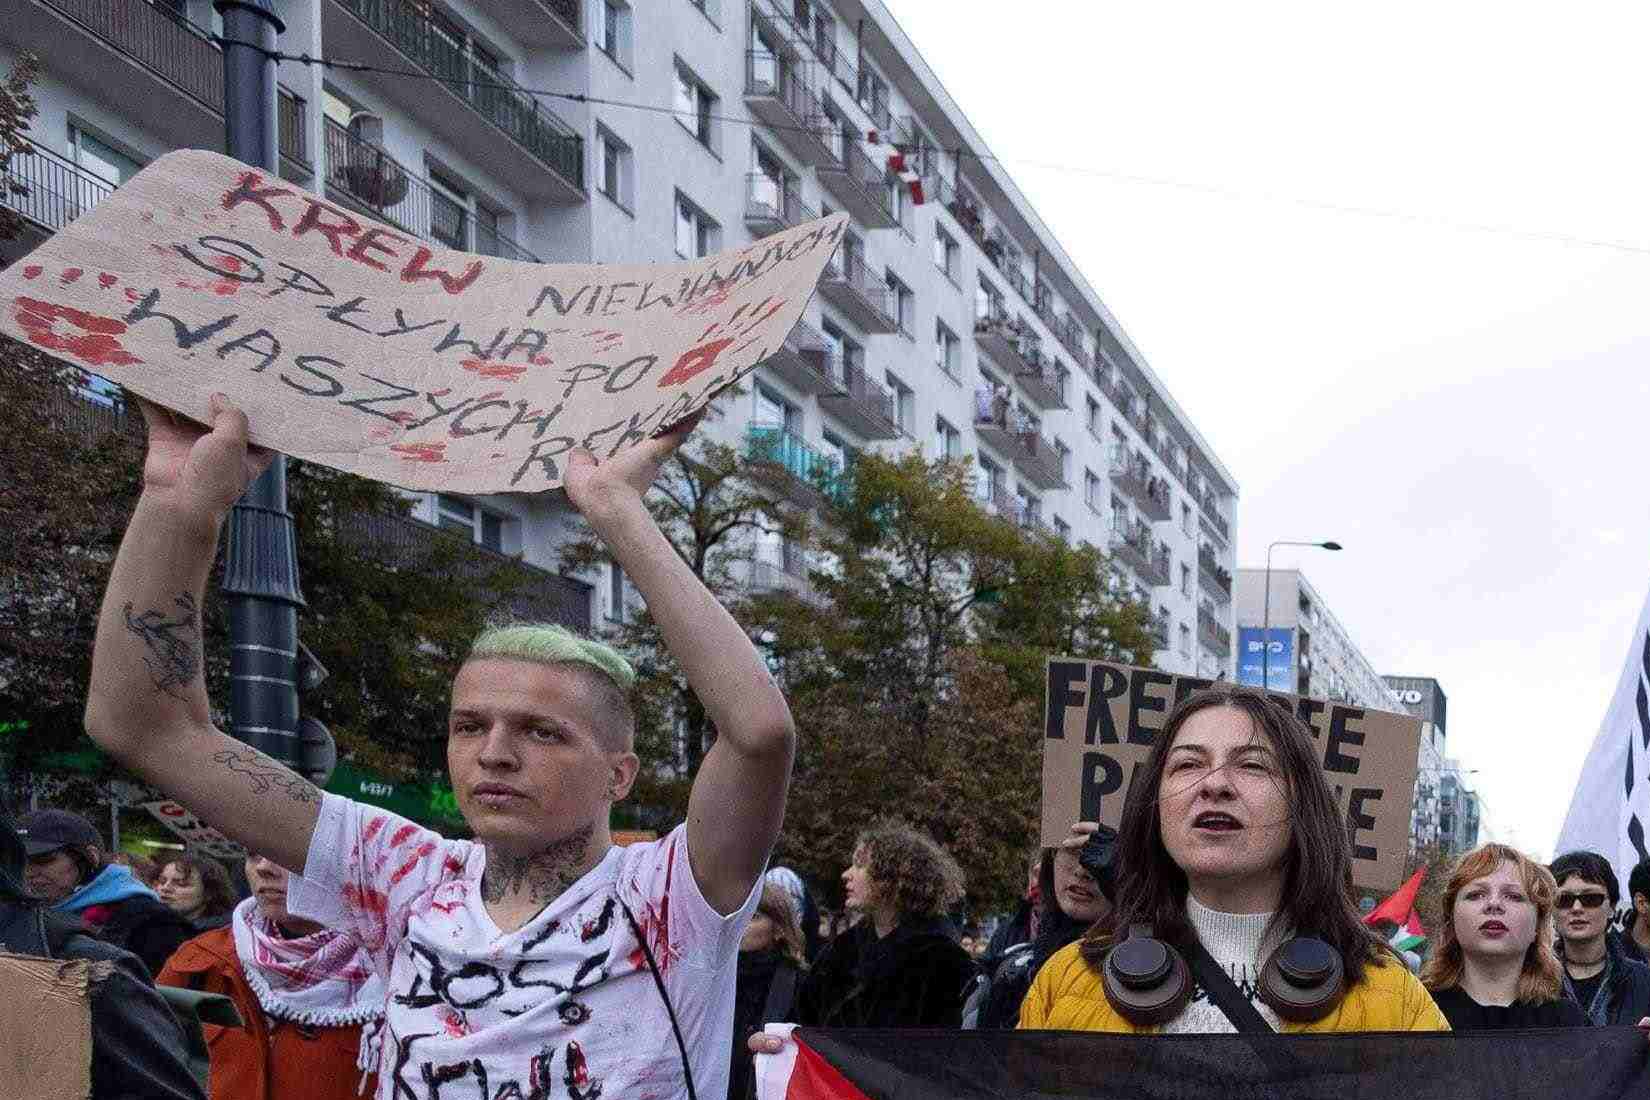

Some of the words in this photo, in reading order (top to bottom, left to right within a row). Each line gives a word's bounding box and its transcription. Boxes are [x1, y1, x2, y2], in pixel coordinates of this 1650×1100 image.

[222, 167, 484, 294] KREW
[122, 288, 563, 441] WASZYCH
[558, 354, 659, 398] PO
[1046, 661, 1213, 745] FRE
